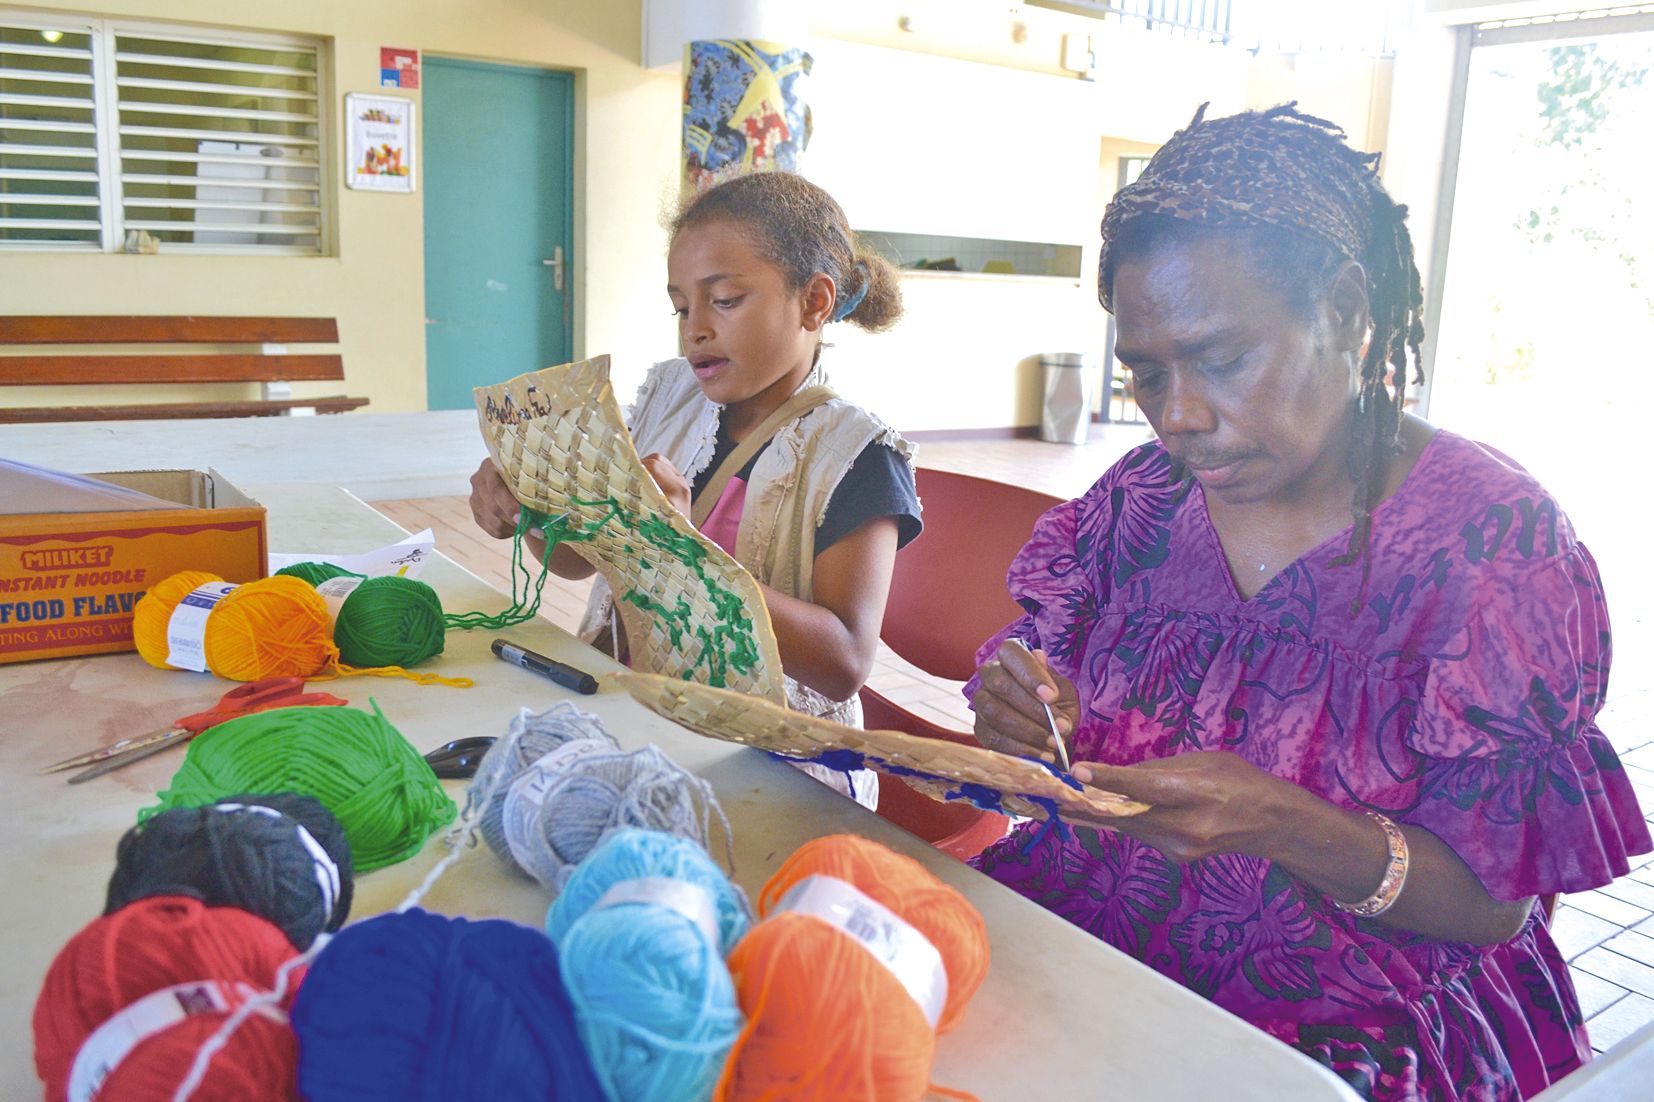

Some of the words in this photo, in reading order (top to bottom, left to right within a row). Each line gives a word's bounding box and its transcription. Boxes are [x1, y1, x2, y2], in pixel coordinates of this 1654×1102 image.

[25, 548, 109, 568] MILIKET
[75, 569, 146, 587] NOODLE
[0, 599, 65, 623] FOOD
[45, 625, 104, 641] ALONG
